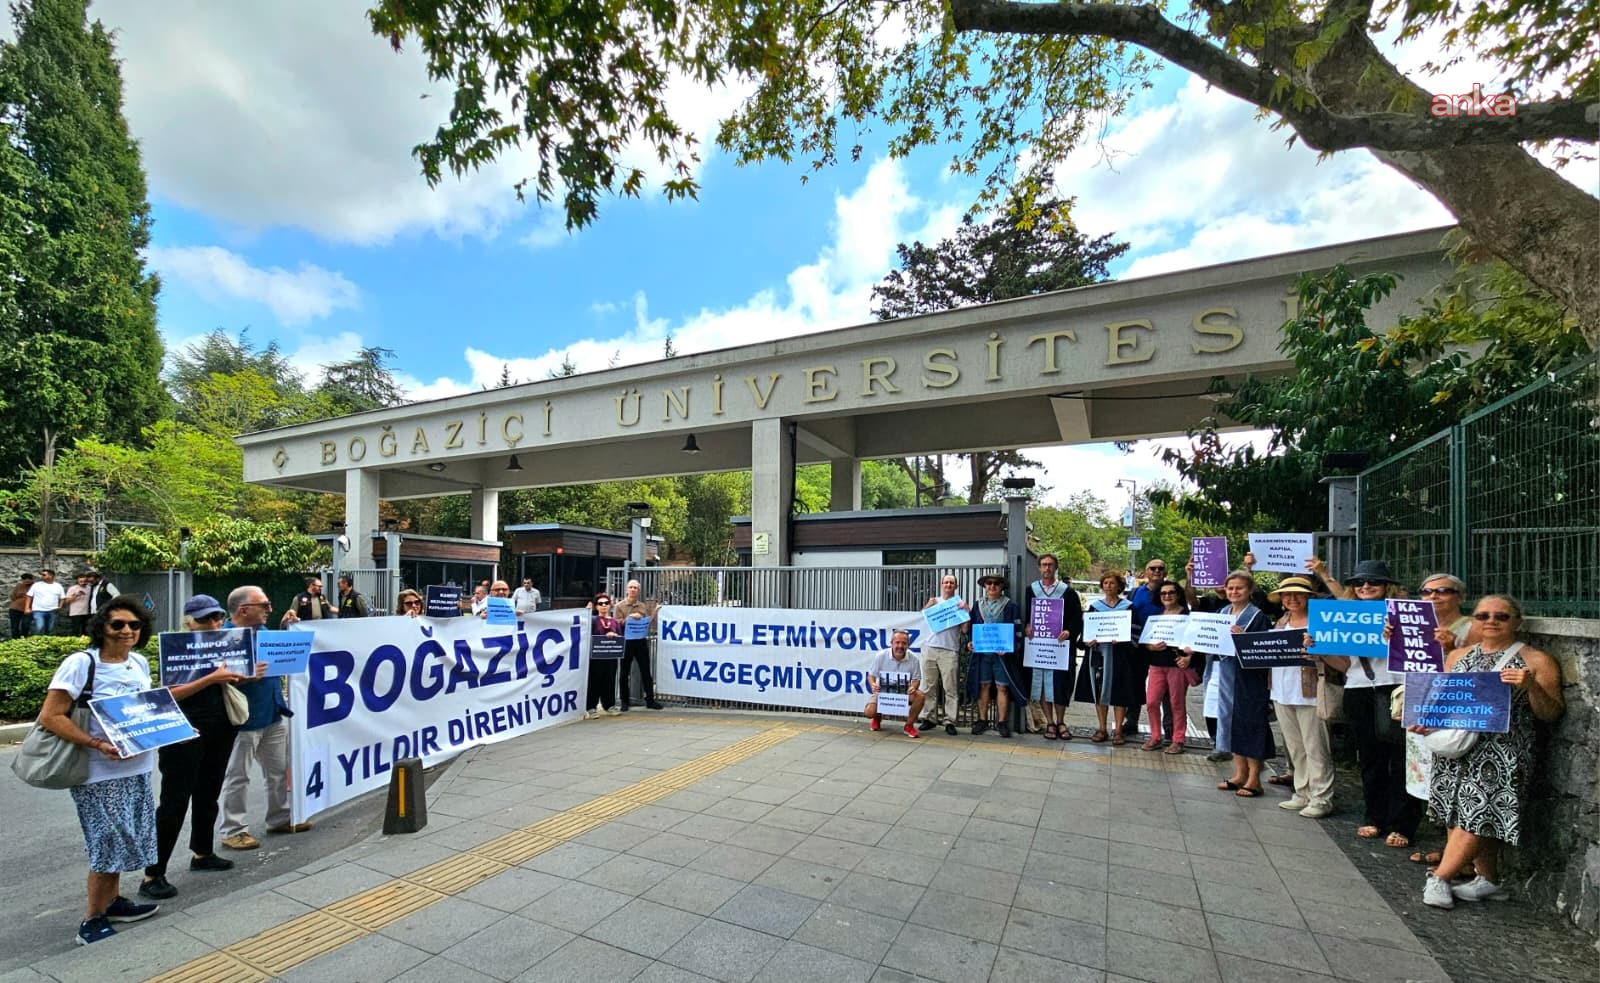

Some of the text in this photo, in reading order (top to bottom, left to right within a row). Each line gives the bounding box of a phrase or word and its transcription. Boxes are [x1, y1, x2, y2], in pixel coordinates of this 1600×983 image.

[319, 401, 557, 467] BOĞAZİÇİ
[1398, 602, 1422, 613] KA-
[1399, 614, 1430, 625] BUL
[661, 620, 743, 645] KABUL
[1401, 625, 1424, 636] ET-
[186, 639, 228, 650] KAMPÜS
[1403, 635, 1429, 648] Mİ-
[167, 649, 247, 662] MEZUNLARA YASAK
[1404, 648, 1433, 659] YO-
[306, 616, 581, 729] BOĞAZİÇİ
[1413, 704, 1493, 715] DEMOKRATİK
[1416, 717, 1488, 729] ÜNİVERSİTE
[305, 690, 578, 798] 4 YILDIR DİRENİYOR
